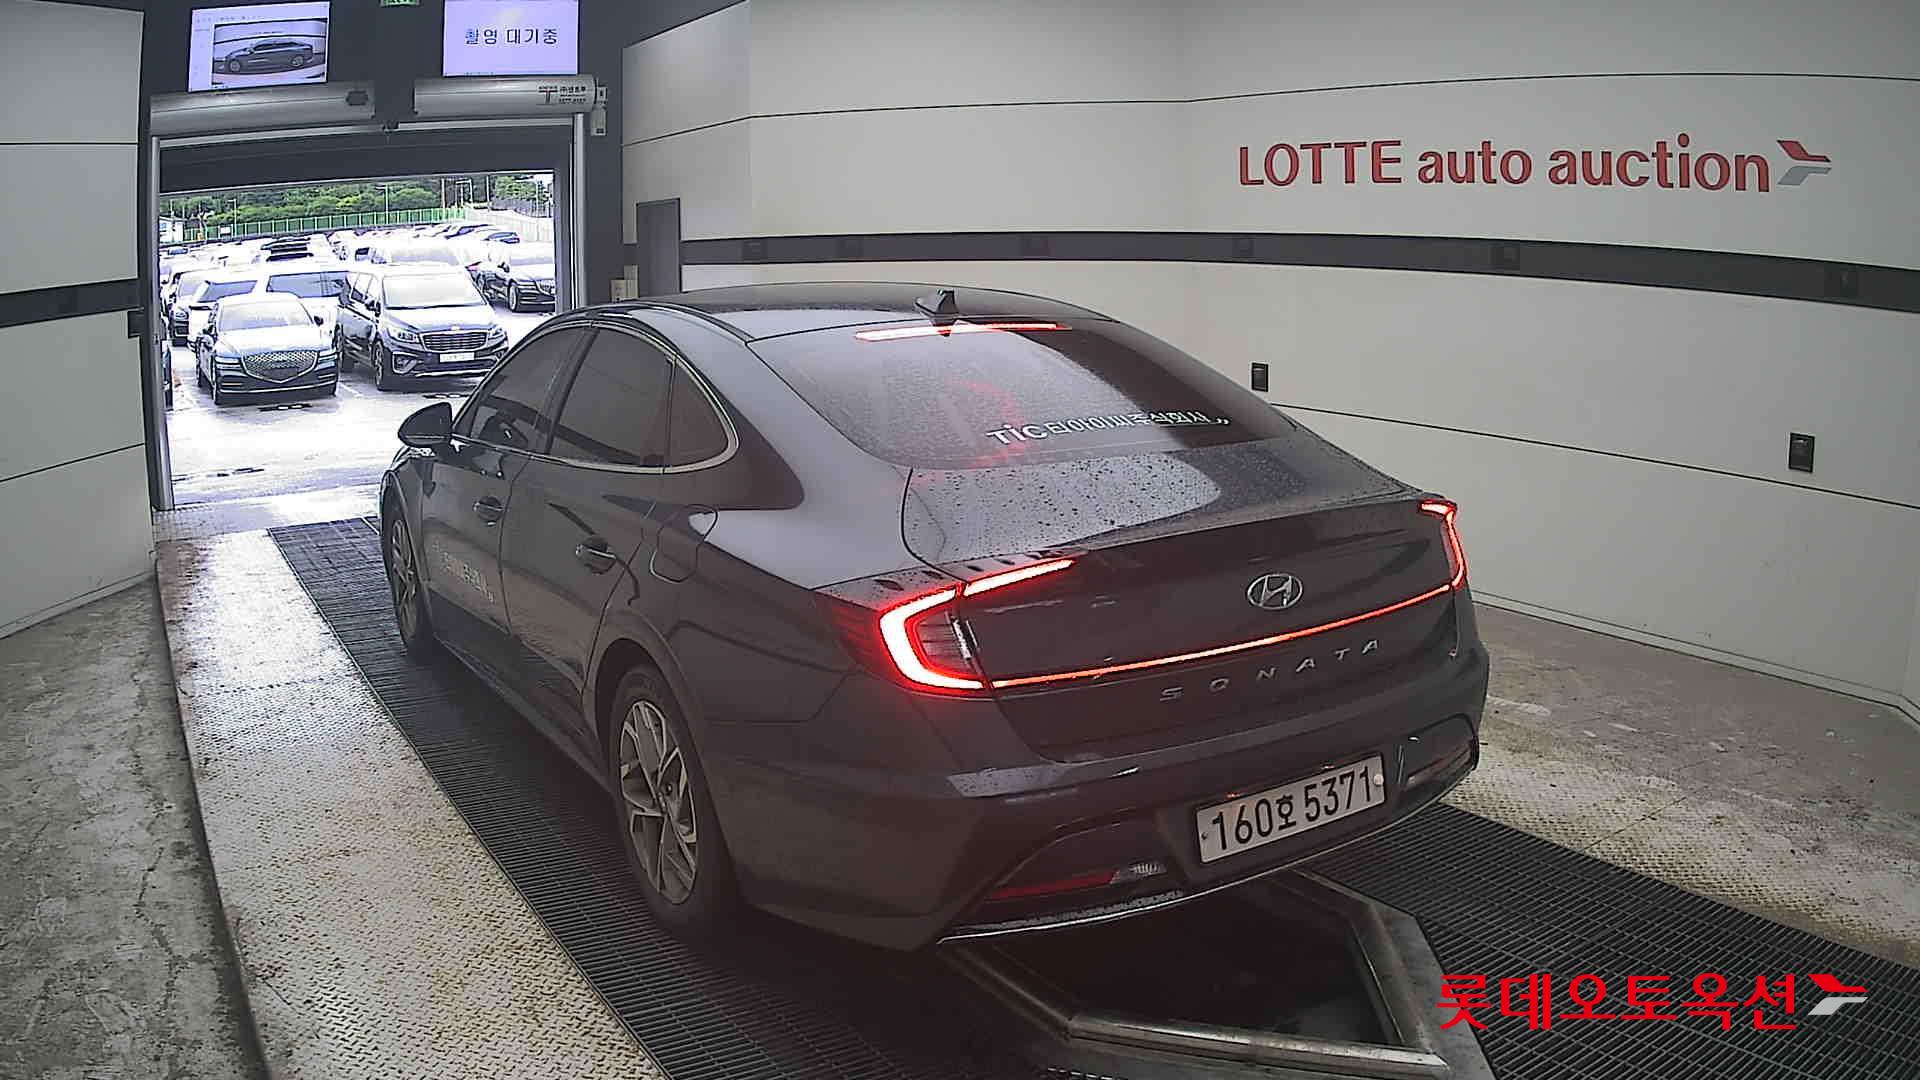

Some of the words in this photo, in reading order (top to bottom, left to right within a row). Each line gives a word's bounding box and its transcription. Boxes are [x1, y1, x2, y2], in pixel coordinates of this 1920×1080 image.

[465, 28, 497, 45] 촬영
[506, 28, 557, 45] 대기중
[1239, 140, 1402, 187] LOTTE
[1417, 141, 1532, 186] auto
[1548, 133, 1770, 193] auction
[1160, 639, 1379, 702] SONATA
[1212, 795, 1297, 850] 160호
[1303, 766, 1371, 822] 5371
